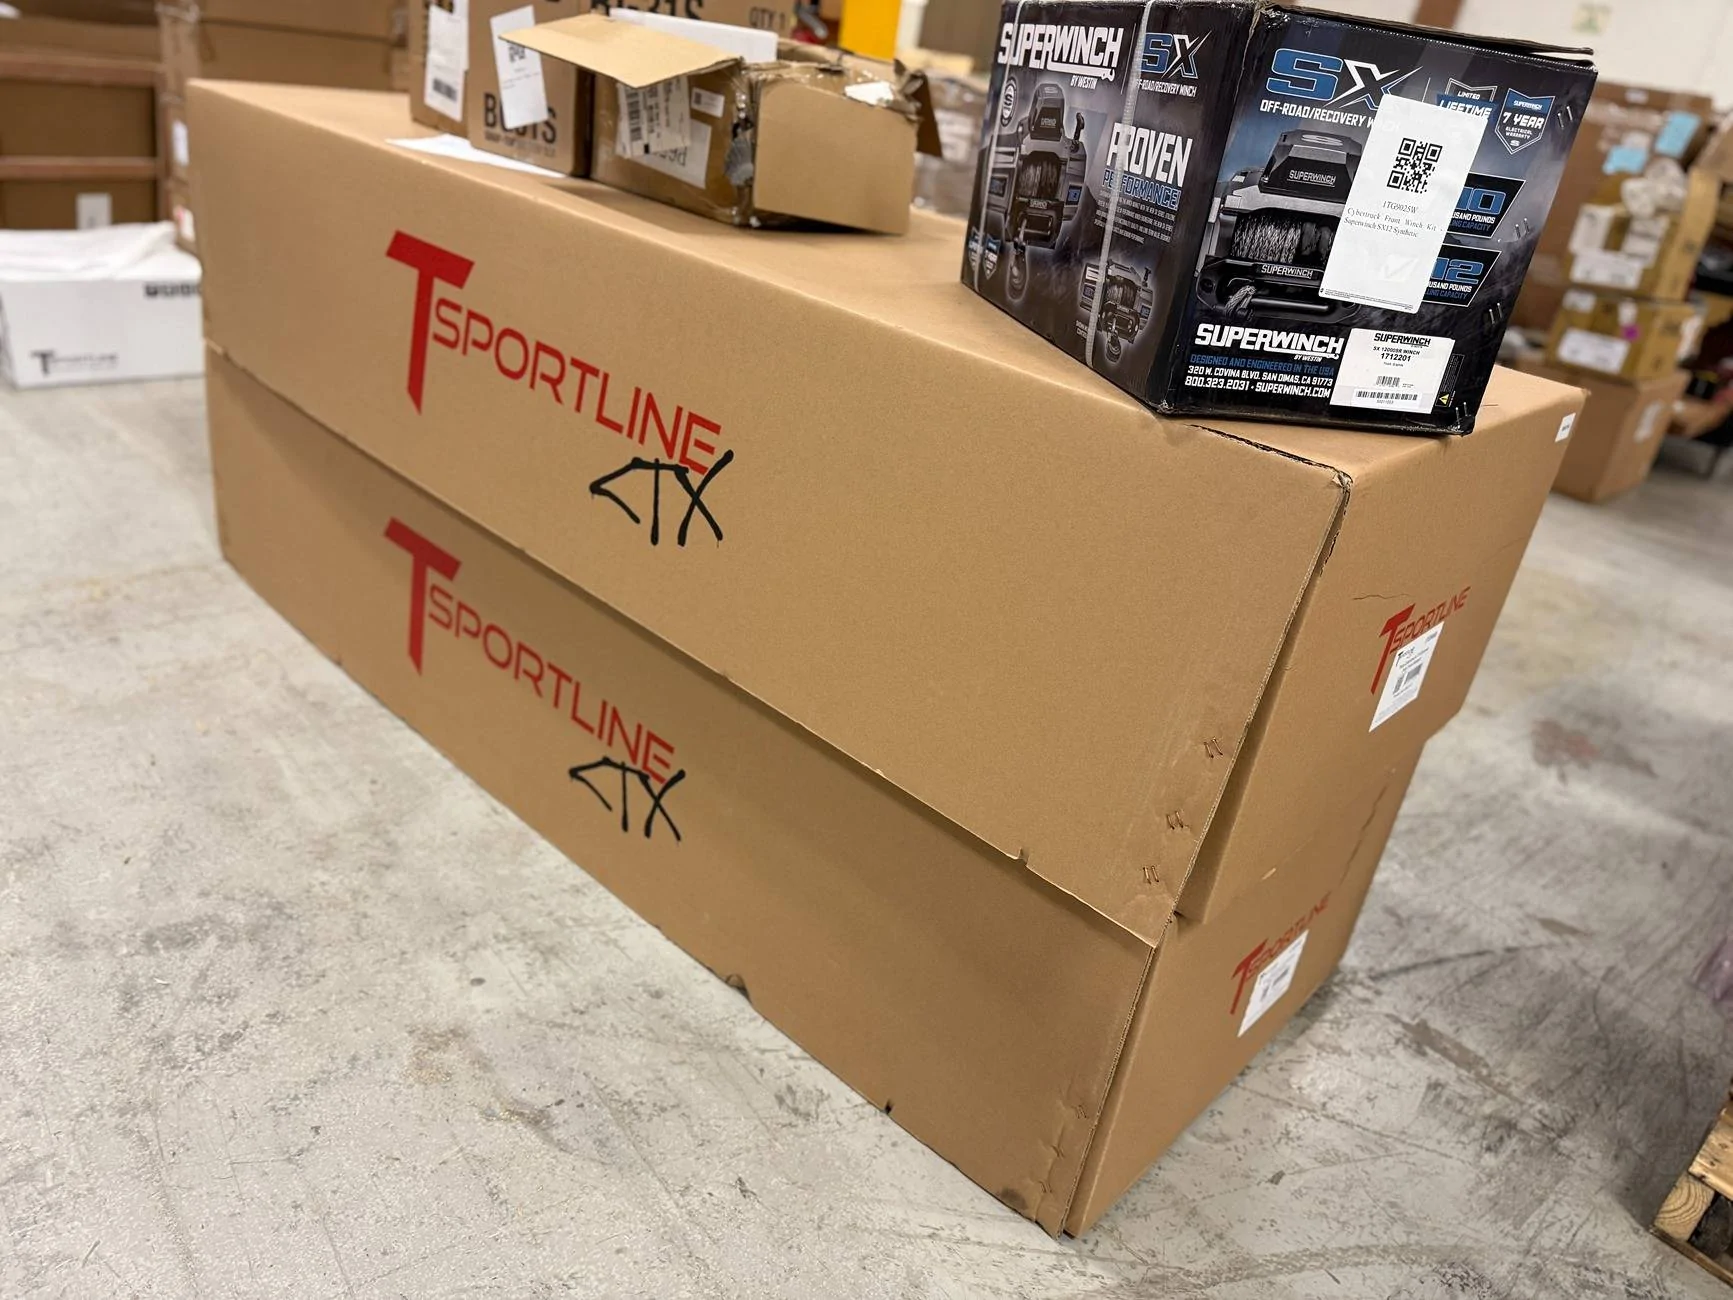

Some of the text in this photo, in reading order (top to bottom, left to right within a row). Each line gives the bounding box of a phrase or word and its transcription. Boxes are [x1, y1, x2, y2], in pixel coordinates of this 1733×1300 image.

[998, 23, 1124, 78] SUPERWINCH
[1141, 31, 1212, 79] SX
[1266, 48, 1423, 110] SX
[1457, 91, 1480, 100] LIMITED
[1260, 100, 1365, 127] OFF-ROAD/RECOVERY
[1503, 112, 1544, 129] 7 YEAR
[1505, 126, 1533, 135] ELECTRICAL
[1505, 131, 1531, 140] WARRANTY
[1107, 122, 1193, 187] PROVEN
[1289, 170, 1336, 187] SUPERWINCH
[1343, 217, 1418, 238] Superwinch SX12 Synthetic
[1347, 207, 1380, 221] Cybertruck
[1384, 213, 1401, 224] Front
[1405, 218, 1423, 229] Winch
[1426, 223, 1437, 232] Kit
[1461, 220, 1491, 231] CAPACITY
[1471, 215, 1495, 224] POUNDS
[1261, 265, 1313, 279] SUPERWINCH
[1431, 257, 1484, 284] 12
[1448, 283, 1472, 293] POUNDS
[1194, 323, 1345, 359] SUPERWINCH
[1374, 333, 1431, 347] SUPERWINCH
[1190, 353, 1335, 376] DESIGNED AND ENGINEERED IN THE USA
[1302, 355, 1323, 363] WESTIN
[1381, 353, 1411, 362] 1712201
[1187, 365, 1205, 375] 320
[1205, 367, 1213, 376] W.
[1213, 368, 1240, 379] COVINA
[1241, 371, 1261, 380] BLVD.
[1261, 372, 1277, 382] SAN
[1301, 376, 1311, 385] CA
[1312, 377, 1334, 387] 91773
[1185, 376, 1332, 398] 800.323.2031 SUPERWINCH.COM
